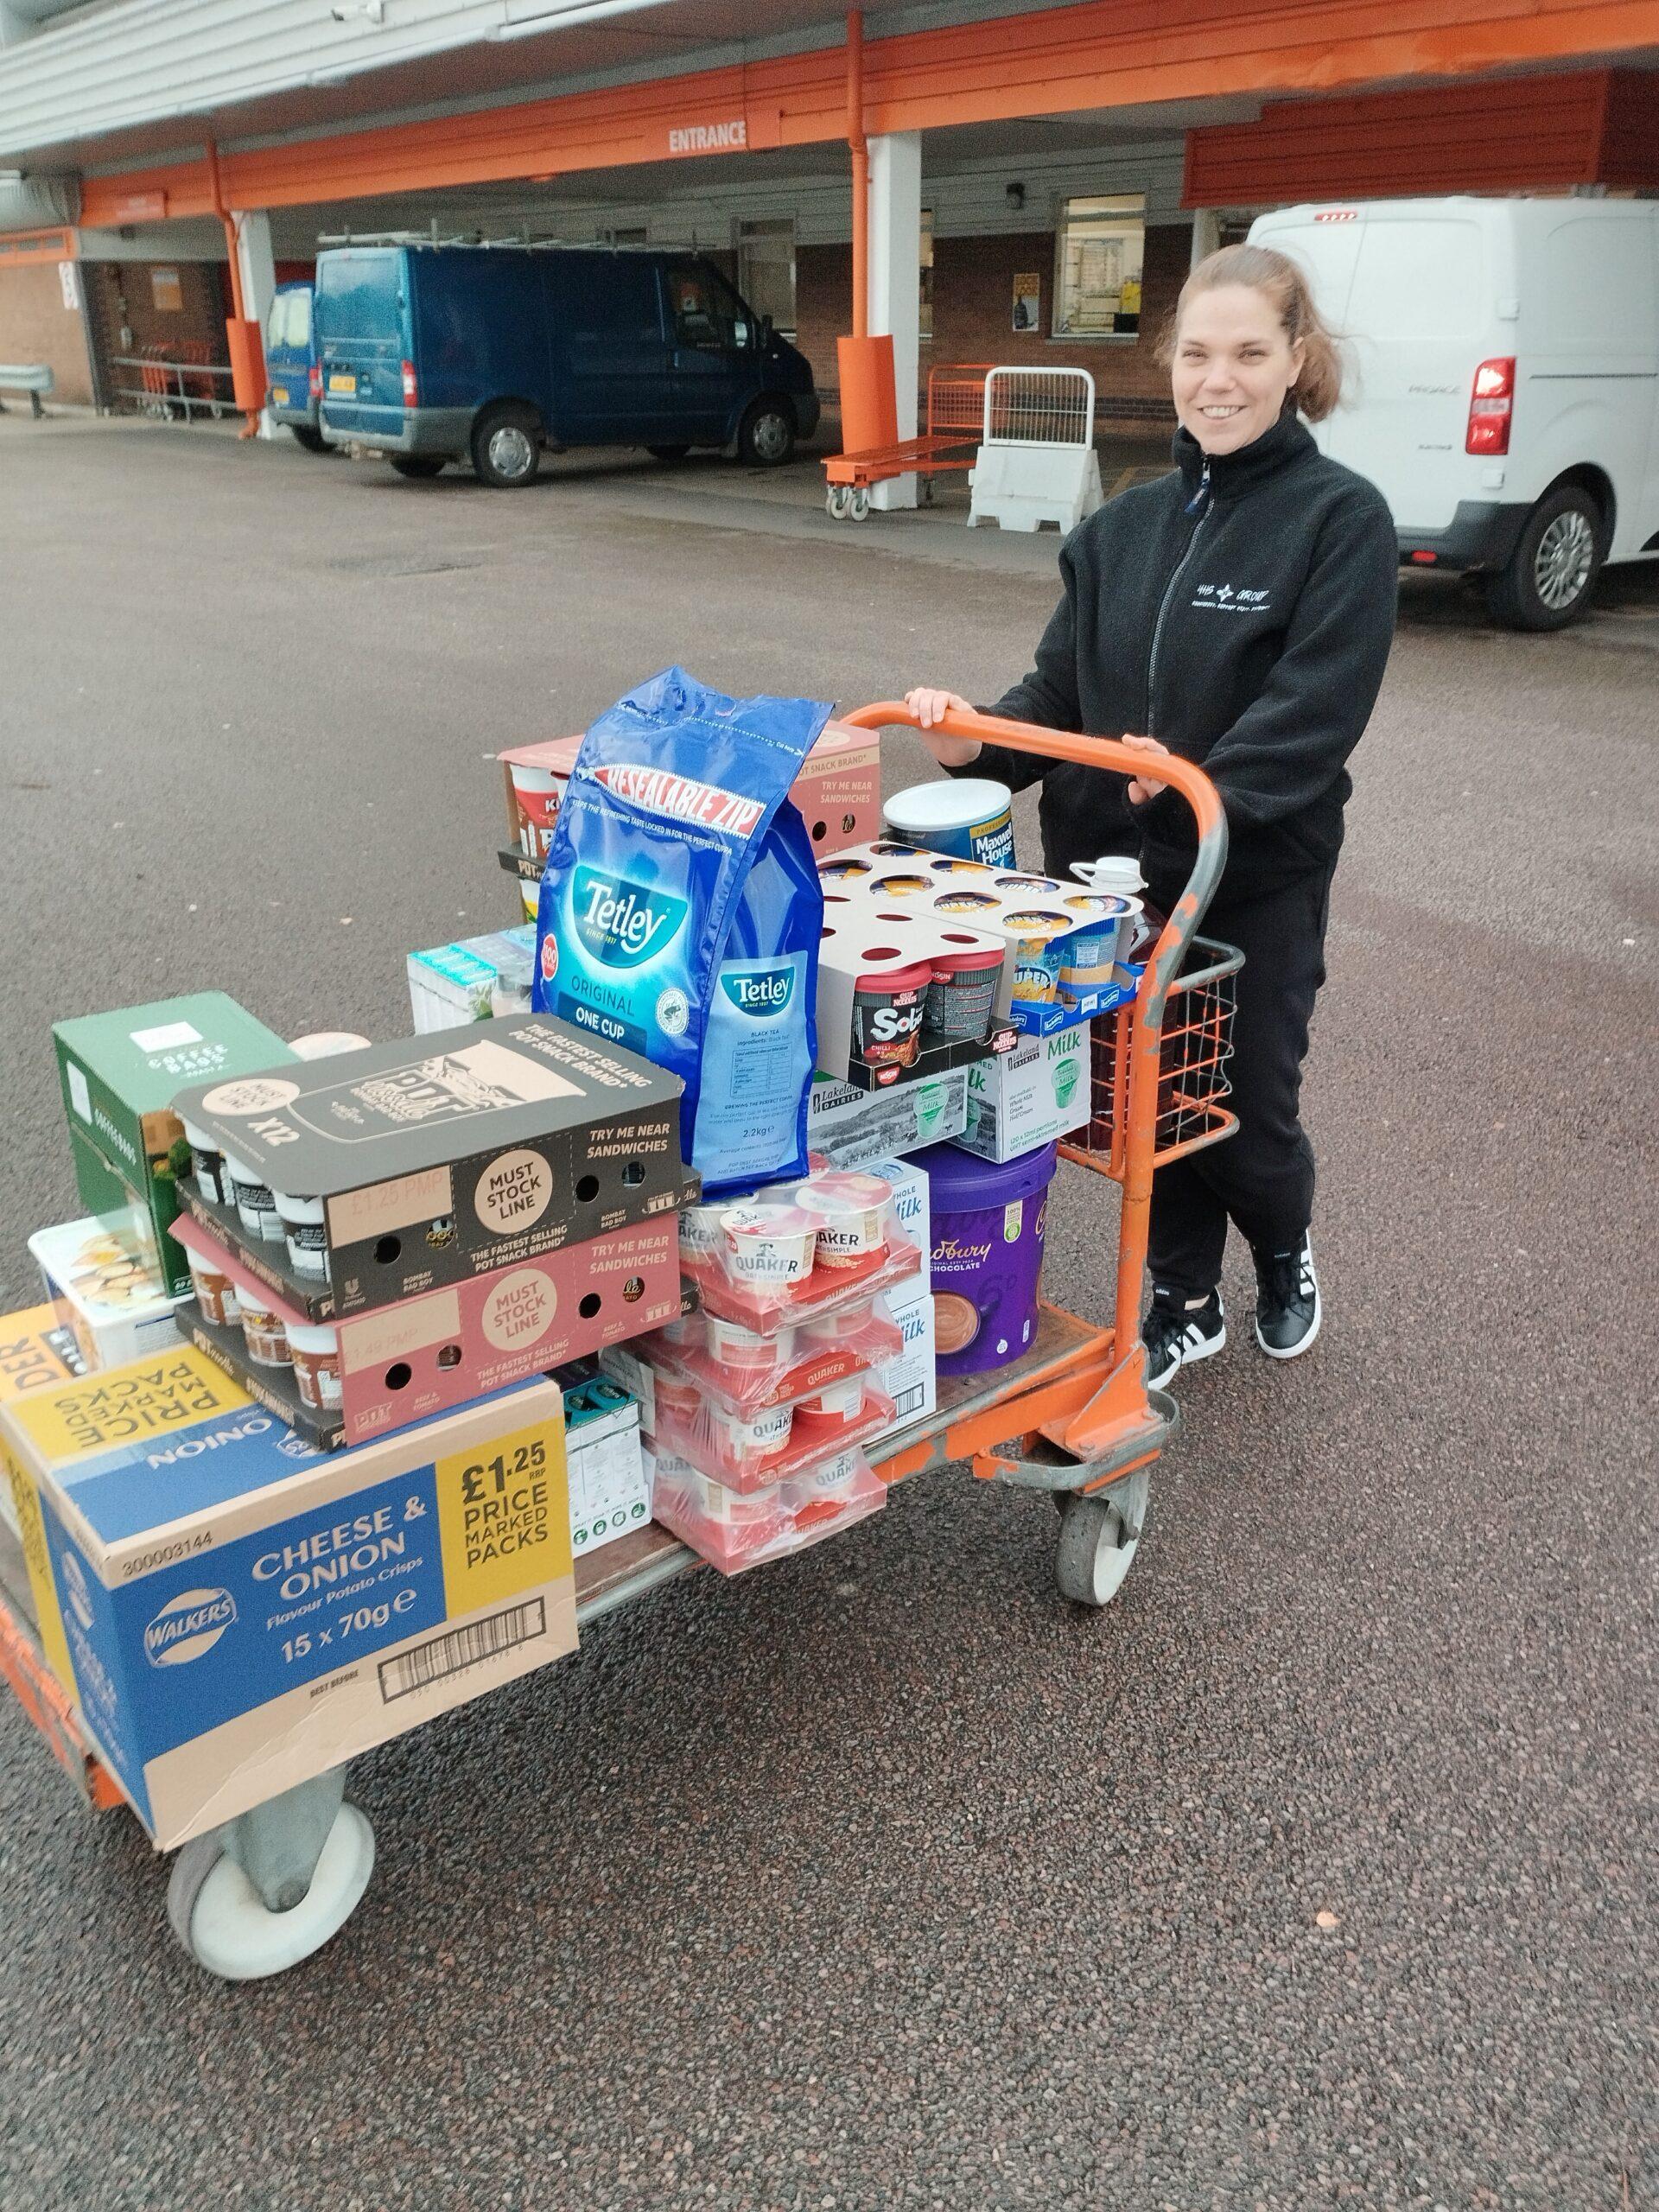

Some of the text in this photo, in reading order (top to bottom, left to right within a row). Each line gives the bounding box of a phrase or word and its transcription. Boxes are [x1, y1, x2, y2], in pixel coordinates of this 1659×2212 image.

[670, 121, 747, 152] ENTRANCE
[810, 761, 836, 775] SNACK
[822, 780, 873, 791] TRY ME NEAR
[607, 766, 759, 833] RESEALABLE ZIP
[820, 794, 871, 804] SANDWICHES
[588, 802, 600, 814] THE
[601, 808, 631, 824] REFRESHING
[631, 817, 645, 830] TASTE
[645, 820, 664, 834] LOCKED
[664, 827, 671, 836] IN
[671, 829, 683, 840] FOR
[683, 832, 693, 842] THE
[693, 835, 715, 851] PERFECT
[714, 843, 733, 856] CUPPA
[982, 839, 1013, 865] House
[583, 880, 668, 955] Tetley
[586, 927, 604, 940] SINCE
[733, 976, 790, 1005] Tetley
[1014, 969, 1051, 988] UPER
[571, 975, 635, 1018] ORIGINAL
[575, 1006, 625, 1041] ONE CUP
[148, 1044, 228, 1070] COFFEE
[509, 1029, 540, 1045] POT
[531, 1040, 578, 1064] SNACK
[525, 1023, 652, 1088] THE FASTEST SELLING
[1014, 1044, 1039, 1062] Lakeland
[1047, 1032, 1082, 1060] Milk
[165, 1053, 225, 1074] BAGS
[822, 1084, 862, 1102] Lakelan
[823, 1092, 862, 1109] DAIRIES
[589, 1123, 671, 1141] TRY ME NEAR
[743, 1127, 766, 1138] 2.2kg
[1037, 1120, 1058, 1132] portions
[587, 1139, 668, 1159] SANDWICHES
[1009, 1142, 1021, 1151] UHT
[490, 1162, 535, 1191] MUST
[486, 1175, 543, 1209] STOCK
[893, 1185, 916, 1200] HOLE
[500, 1195, 536, 1220] LINE
[601, 1209, 626, 1222] BOMBAY
[601, 1215, 627, 1229] BAD BOY
[470, 1224, 568, 1262] THE FASTEST SELLING
[591, 1236, 669, 1257] TRY ME NEAR
[930, 1239, 992, 1262] dbury
[475, 1258, 495, 1273] POT
[496, 1248, 528, 1266] SNACK
[589, 1252, 667, 1274] SANDWICHES
[736, 1255, 799, 1274] QUAKER
[930, 1262, 981, 1272] CHOCOLATE
[404, 1270, 431, 1285] BOMBAY
[404, 1276, 433, 1293] BAD BOY
[497, 1281, 539, 1311] MUST
[493, 1295, 546, 1328] STOCK
[506, 1312, 541, 1338] LINE
[602, 1326, 626, 1339] TOMATO
[604, 1323, 618, 1332] BEEF
[901, 1319, 925, 1342] ilk
[477, 1338, 569, 1381] THE FASTEST SELLING
[481, 1376, 499, 1389] POT
[500, 1365, 531, 1380] SNACK
[807, 1363, 845, 1386] QUAKER
[54, 1361, 195, 1415] PACKS
[65, 1376, 207, 1427] MARKED
[414, 1397, 441, 1410] TOMATO
[71, 1389, 221, 1448] PRICE
[147, 1418, 273, 1470] ONION
[461, 1440, 546, 1506] £1.25
[529, 1467, 546, 1482] RRP
[464, 1480, 549, 1532] PRICE
[251, 1496, 428, 1581] CHEESE &
[465, 1506, 549, 1549] MARKED
[466, 1523, 549, 1571] PACKS
[279, 1531, 406, 1600] ONION
[266, 1555, 423, 1631] Flavour Potato Crisps
[145, 1599, 232, 1650] WALKERS
[282, 1603, 389, 1665] 15 x 70g
[309, 1683, 330, 1699] BEST
